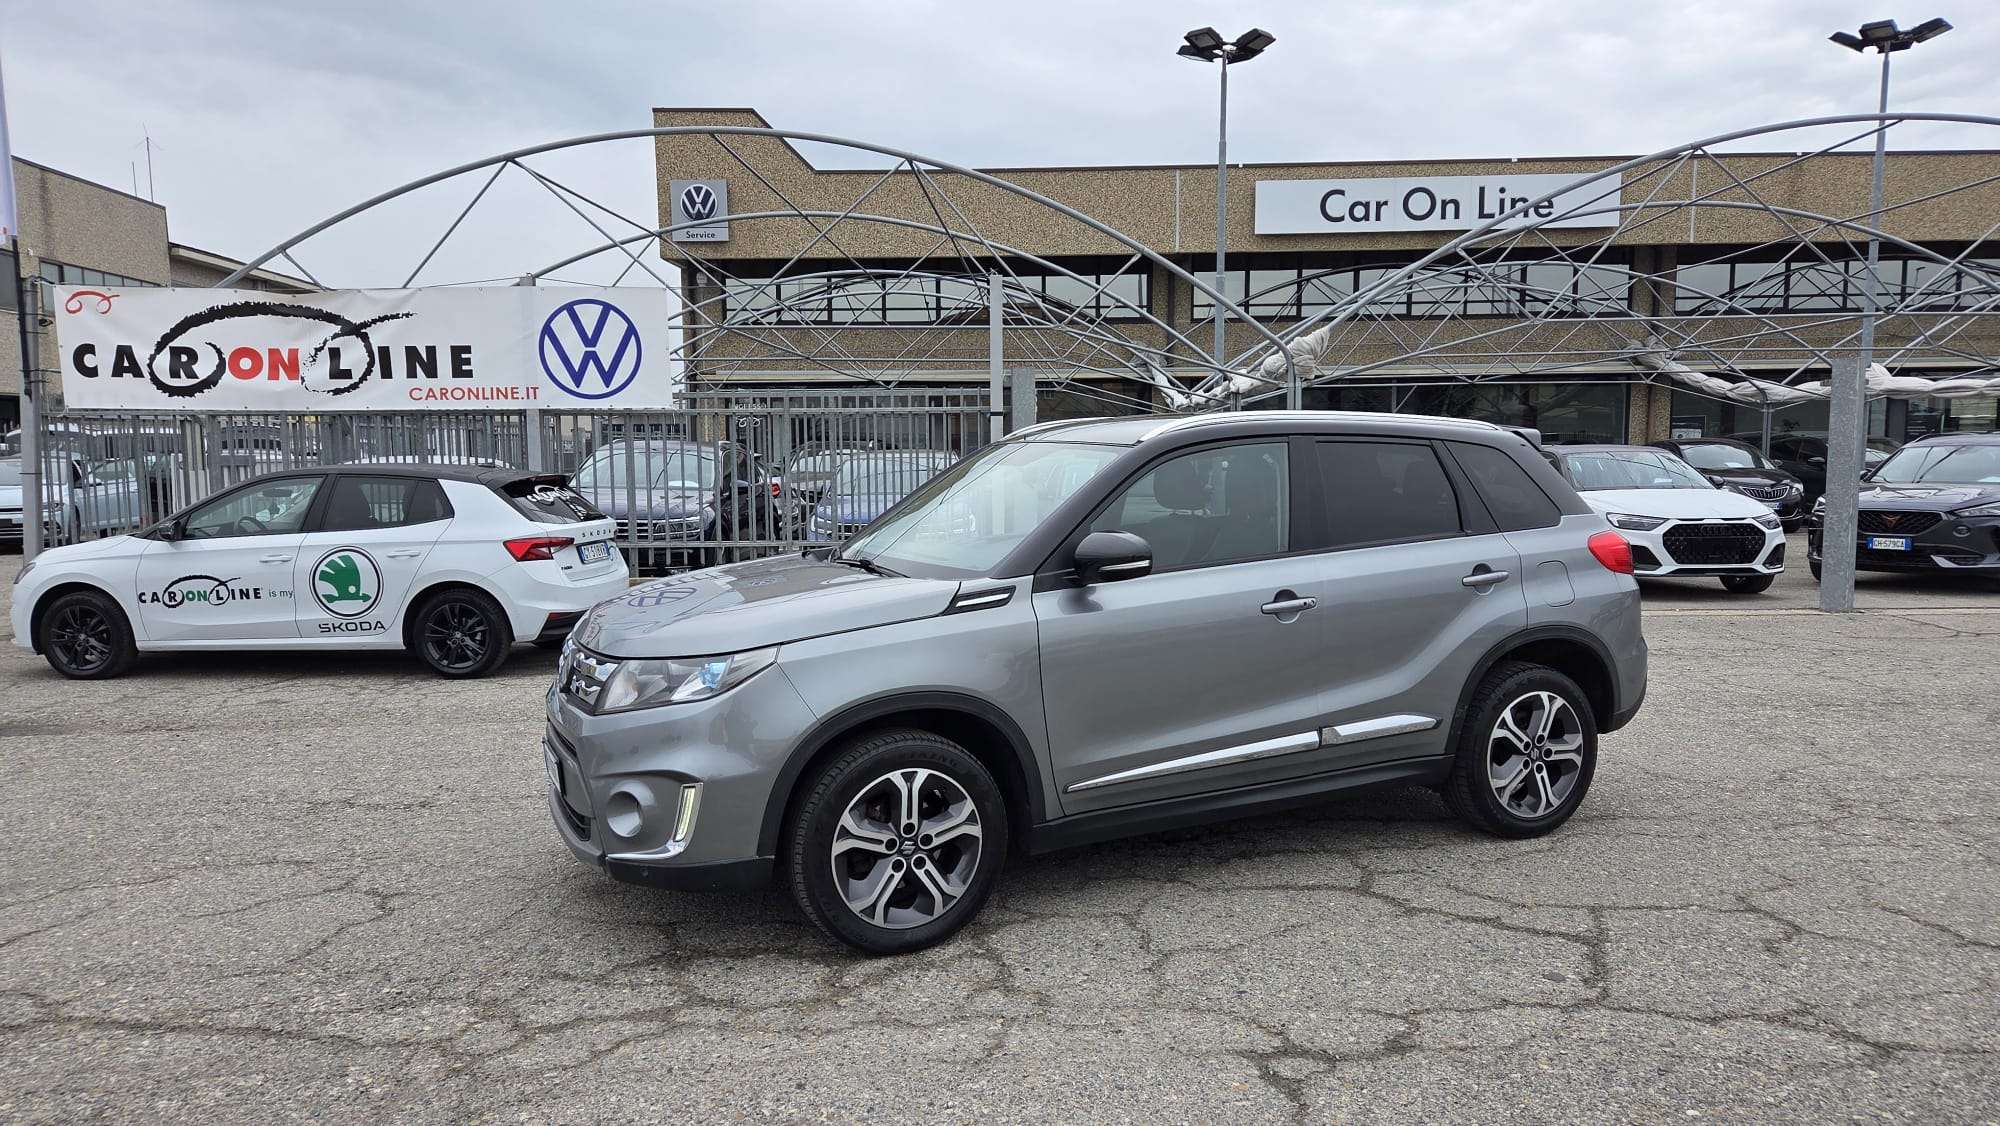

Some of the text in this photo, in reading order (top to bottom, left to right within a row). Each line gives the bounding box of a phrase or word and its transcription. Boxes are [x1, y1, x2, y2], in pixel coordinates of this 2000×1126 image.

[1319, 186, 1554, 223] Car On Line
[686, 230, 716, 239] Service
[409, 386, 540, 401] CARONLINE.IT
[268, 586, 277, 598] is
[279, 590, 294, 599] my
